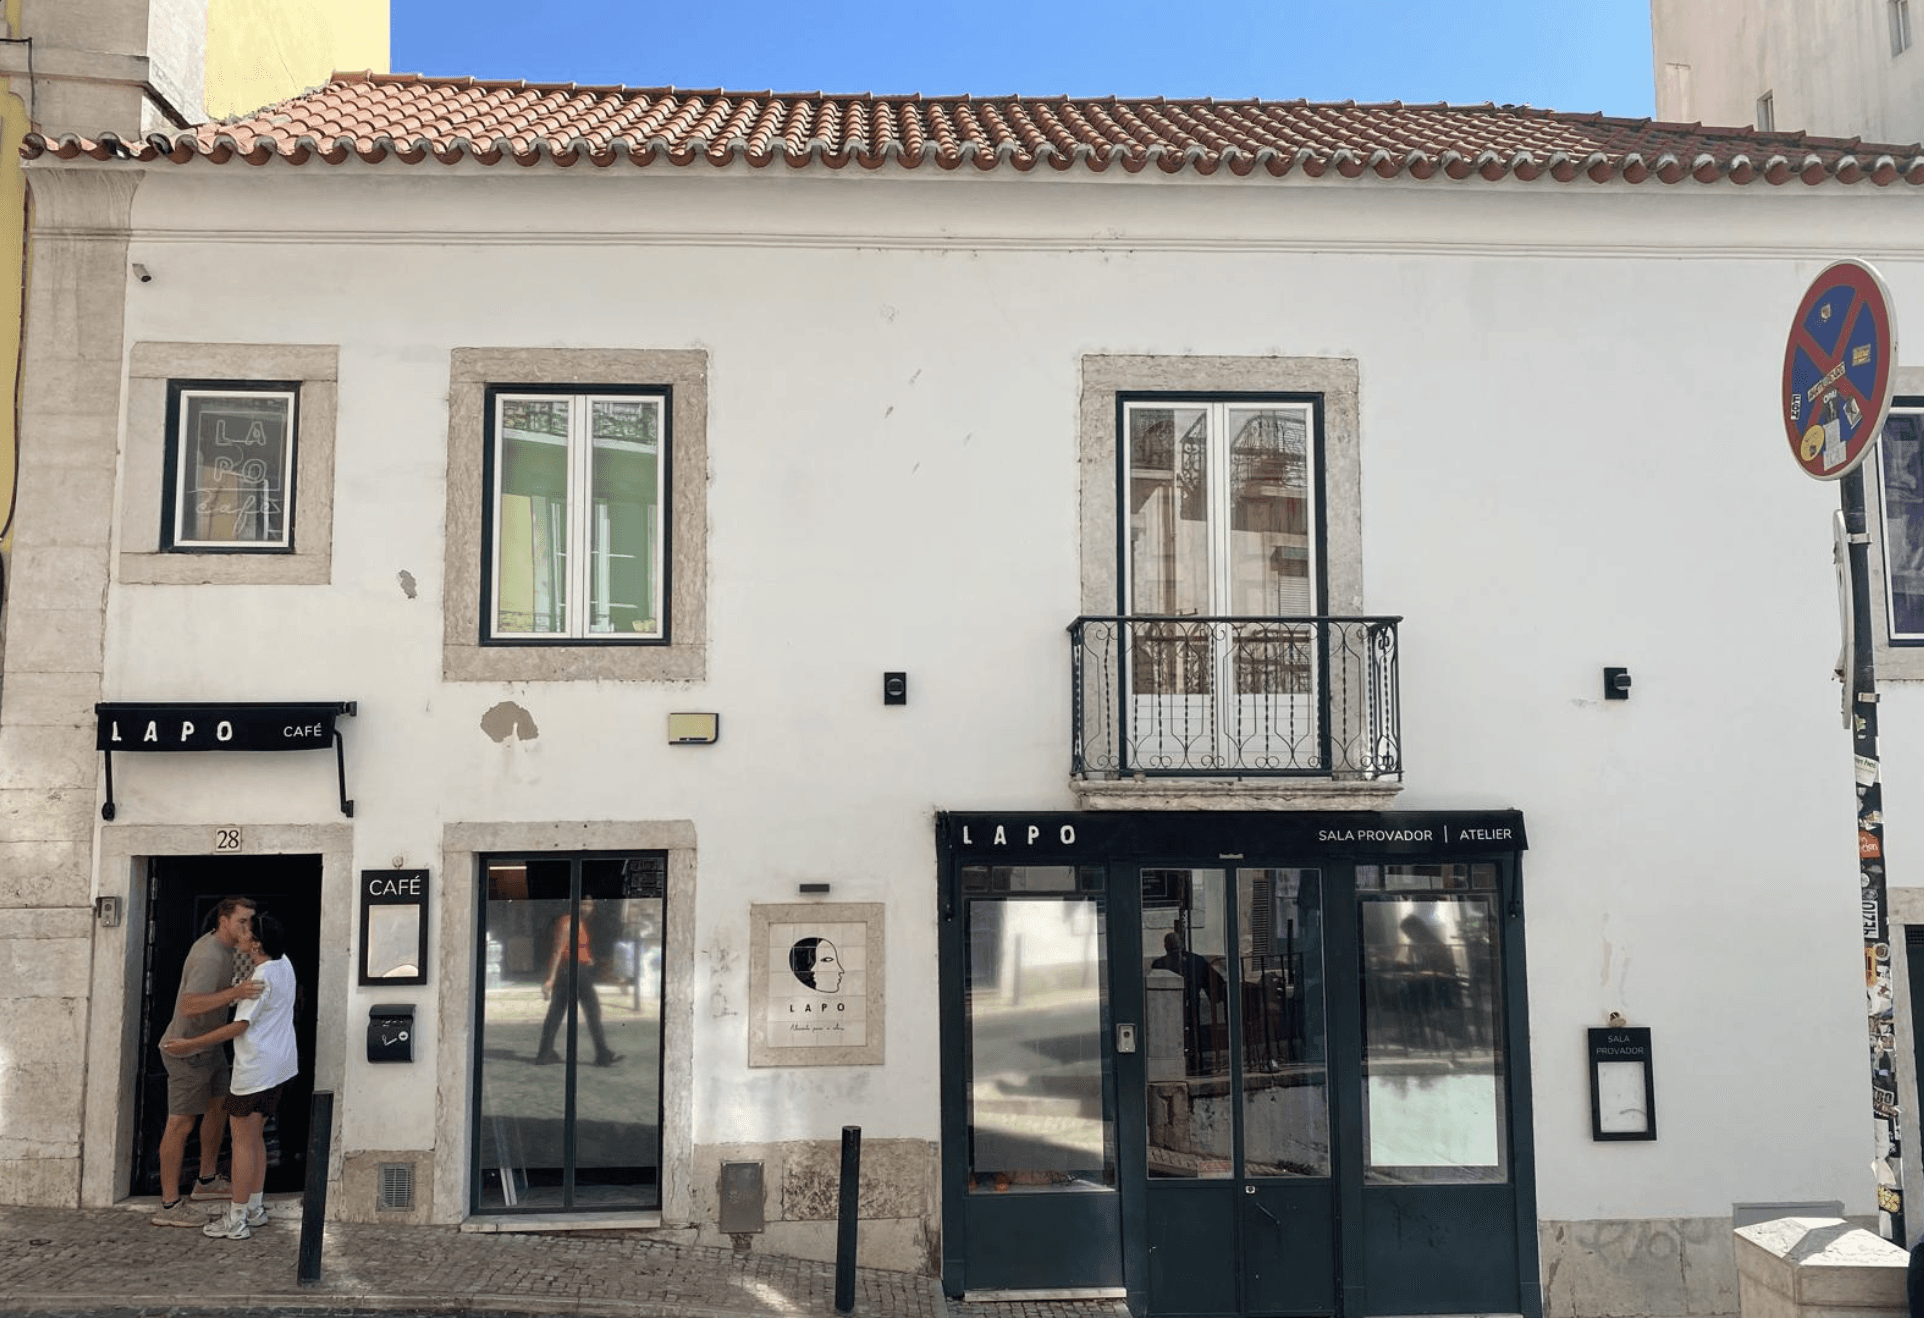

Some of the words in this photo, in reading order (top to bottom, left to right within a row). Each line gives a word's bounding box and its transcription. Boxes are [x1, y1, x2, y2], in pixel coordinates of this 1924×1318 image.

[215, 419, 267, 447] LA
[214, 456, 268, 484] PO
[111, 721, 234, 742] LAPO
[283, 723, 323, 738] CAFÉ
[216, 829, 240, 850] 28
[962, 825, 1076, 845] LAPO
[1318, 830, 1355, 842] SALA
[1357, 829, 1433, 842] PROVADOR
[1459, 828, 1513, 841] ATELIER
[368, 875, 422, 896] CAFÉ
[789, 1003, 845, 1013] LAPO
[1607, 1035, 1631, 1043] SALA
[1596, 1046, 1644, 1055] PROVADOR
